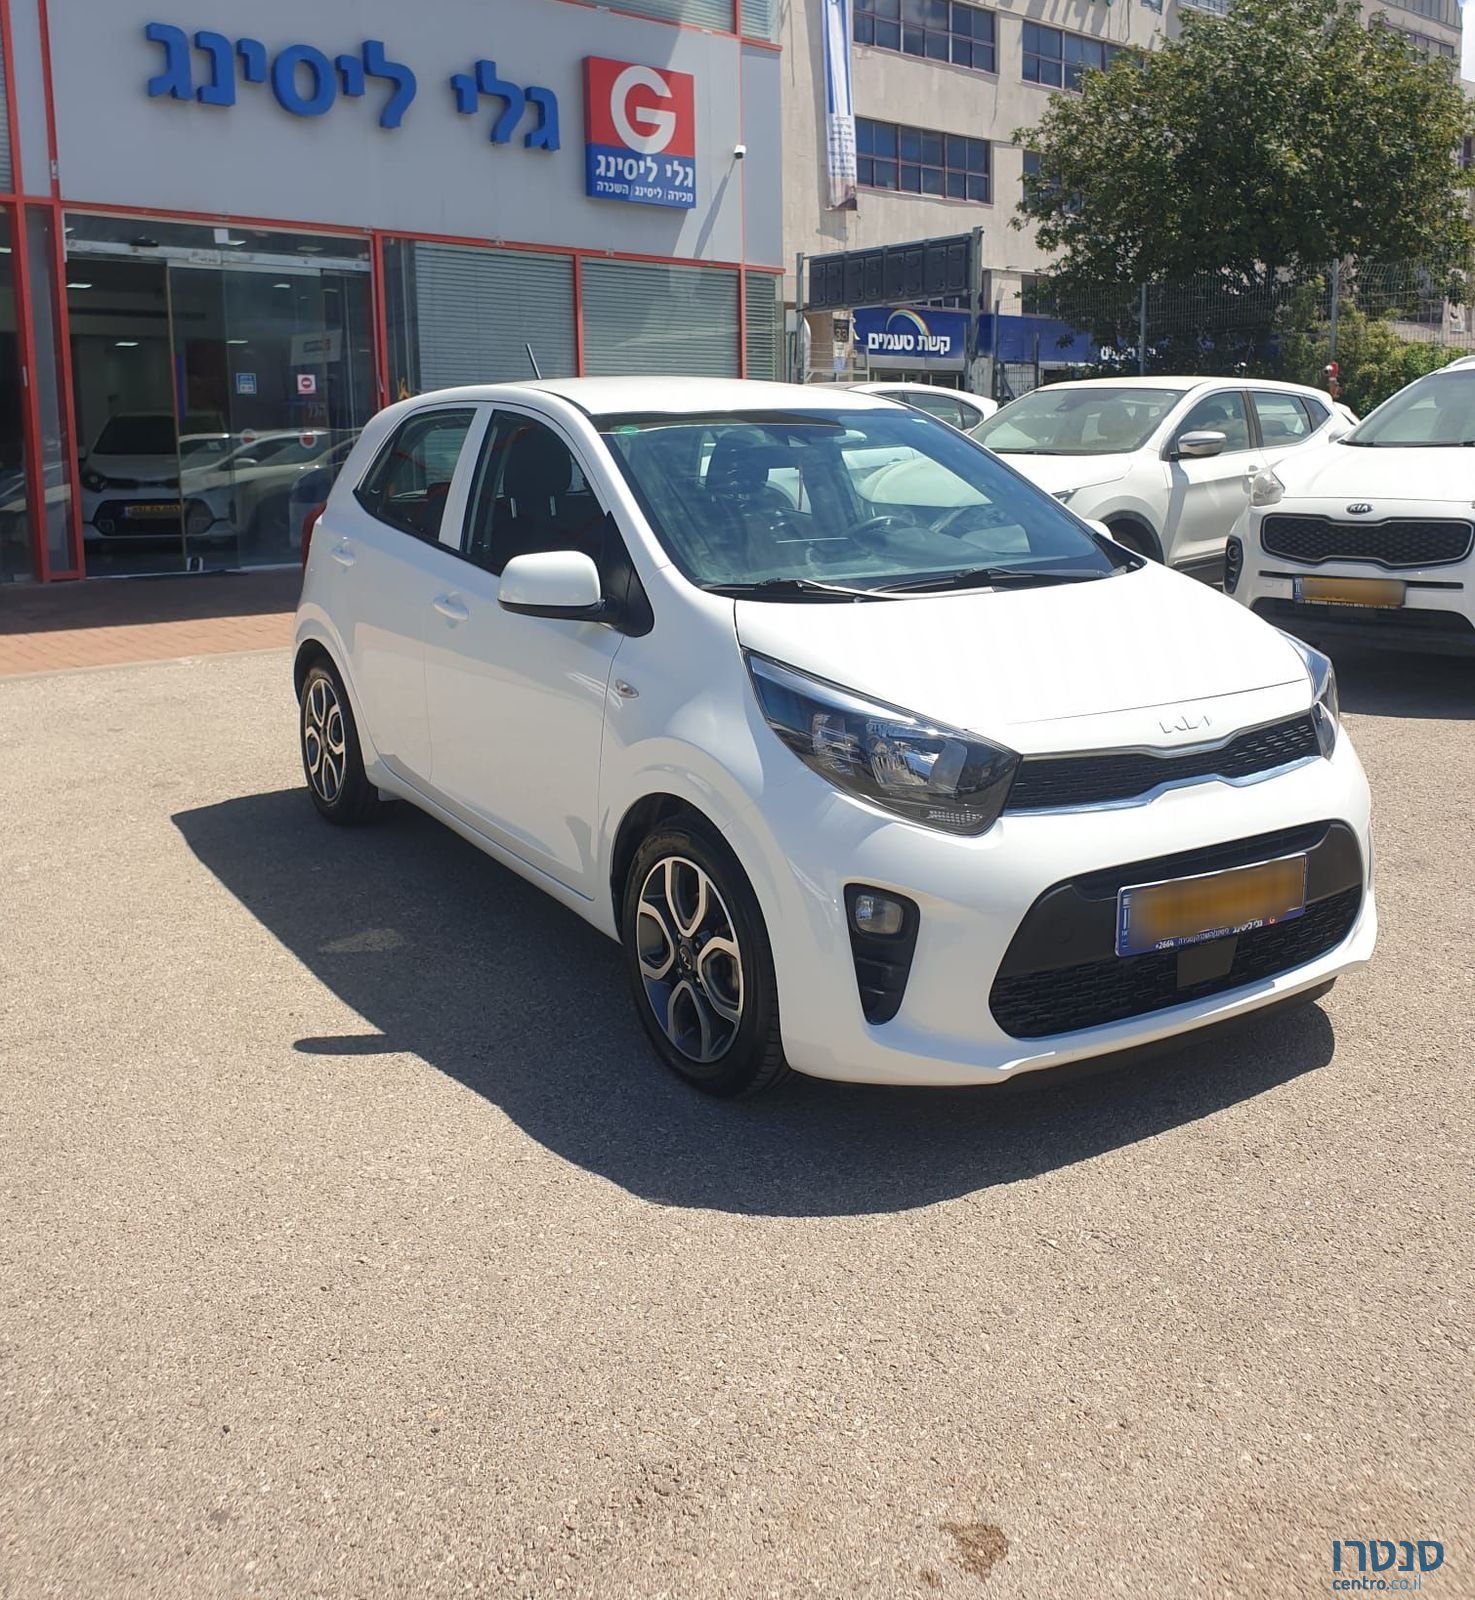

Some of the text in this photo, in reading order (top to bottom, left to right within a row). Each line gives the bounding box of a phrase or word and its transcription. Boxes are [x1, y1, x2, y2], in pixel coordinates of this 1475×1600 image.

[145, 21, 561, 152] גלי ליסינג
[610, 65, 677, 155] G
[595, 154, 694, 188] גלי ליסינג
[596, 180, 694, 203] מכירה ליסינג השכרה
[867, 332, 914, 351] טעמים
[917, 335, 951, 355] קשת
